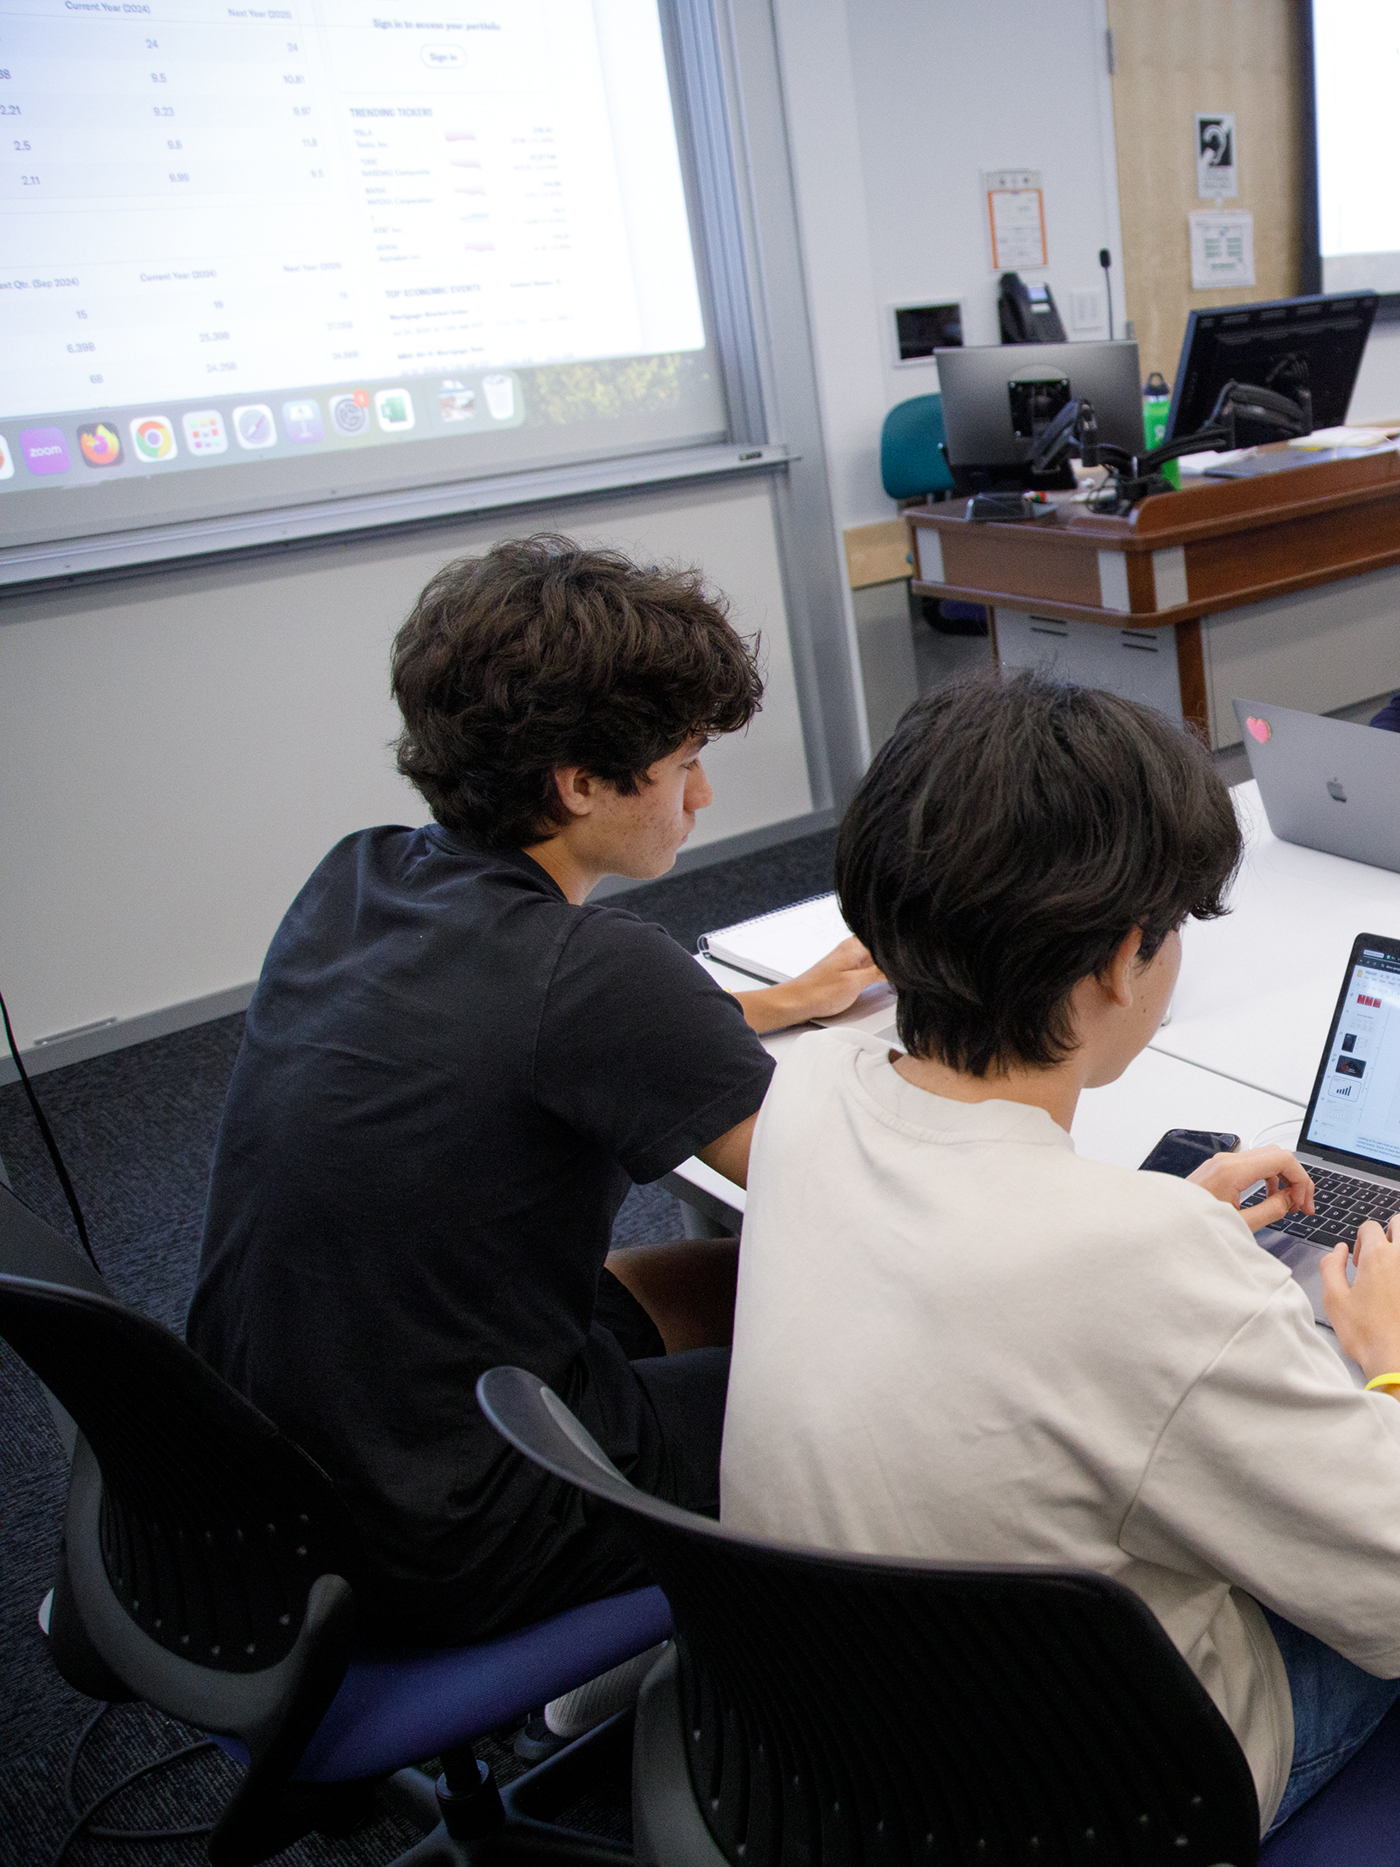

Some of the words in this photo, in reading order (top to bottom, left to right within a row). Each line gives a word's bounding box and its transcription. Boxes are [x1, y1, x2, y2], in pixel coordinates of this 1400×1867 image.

[65, 0, 100, 12] Current
[102, 2, 122, 13] Year
[146, 38, 158, 50] 24
[286, 42, 298, 52] 24
[350, 107, 396, 118] TRENDING
[14, 140, 32, 151] 2.5
[54, 276, 80, 288] 2024)
[140, 272, 172, 283] Current
[76, 310, 88, 320] 15
[66, 342, 96, 354] 6.39B
[90, 374, 104, 385] 6B
[30, 445, 62, 458] zoom
